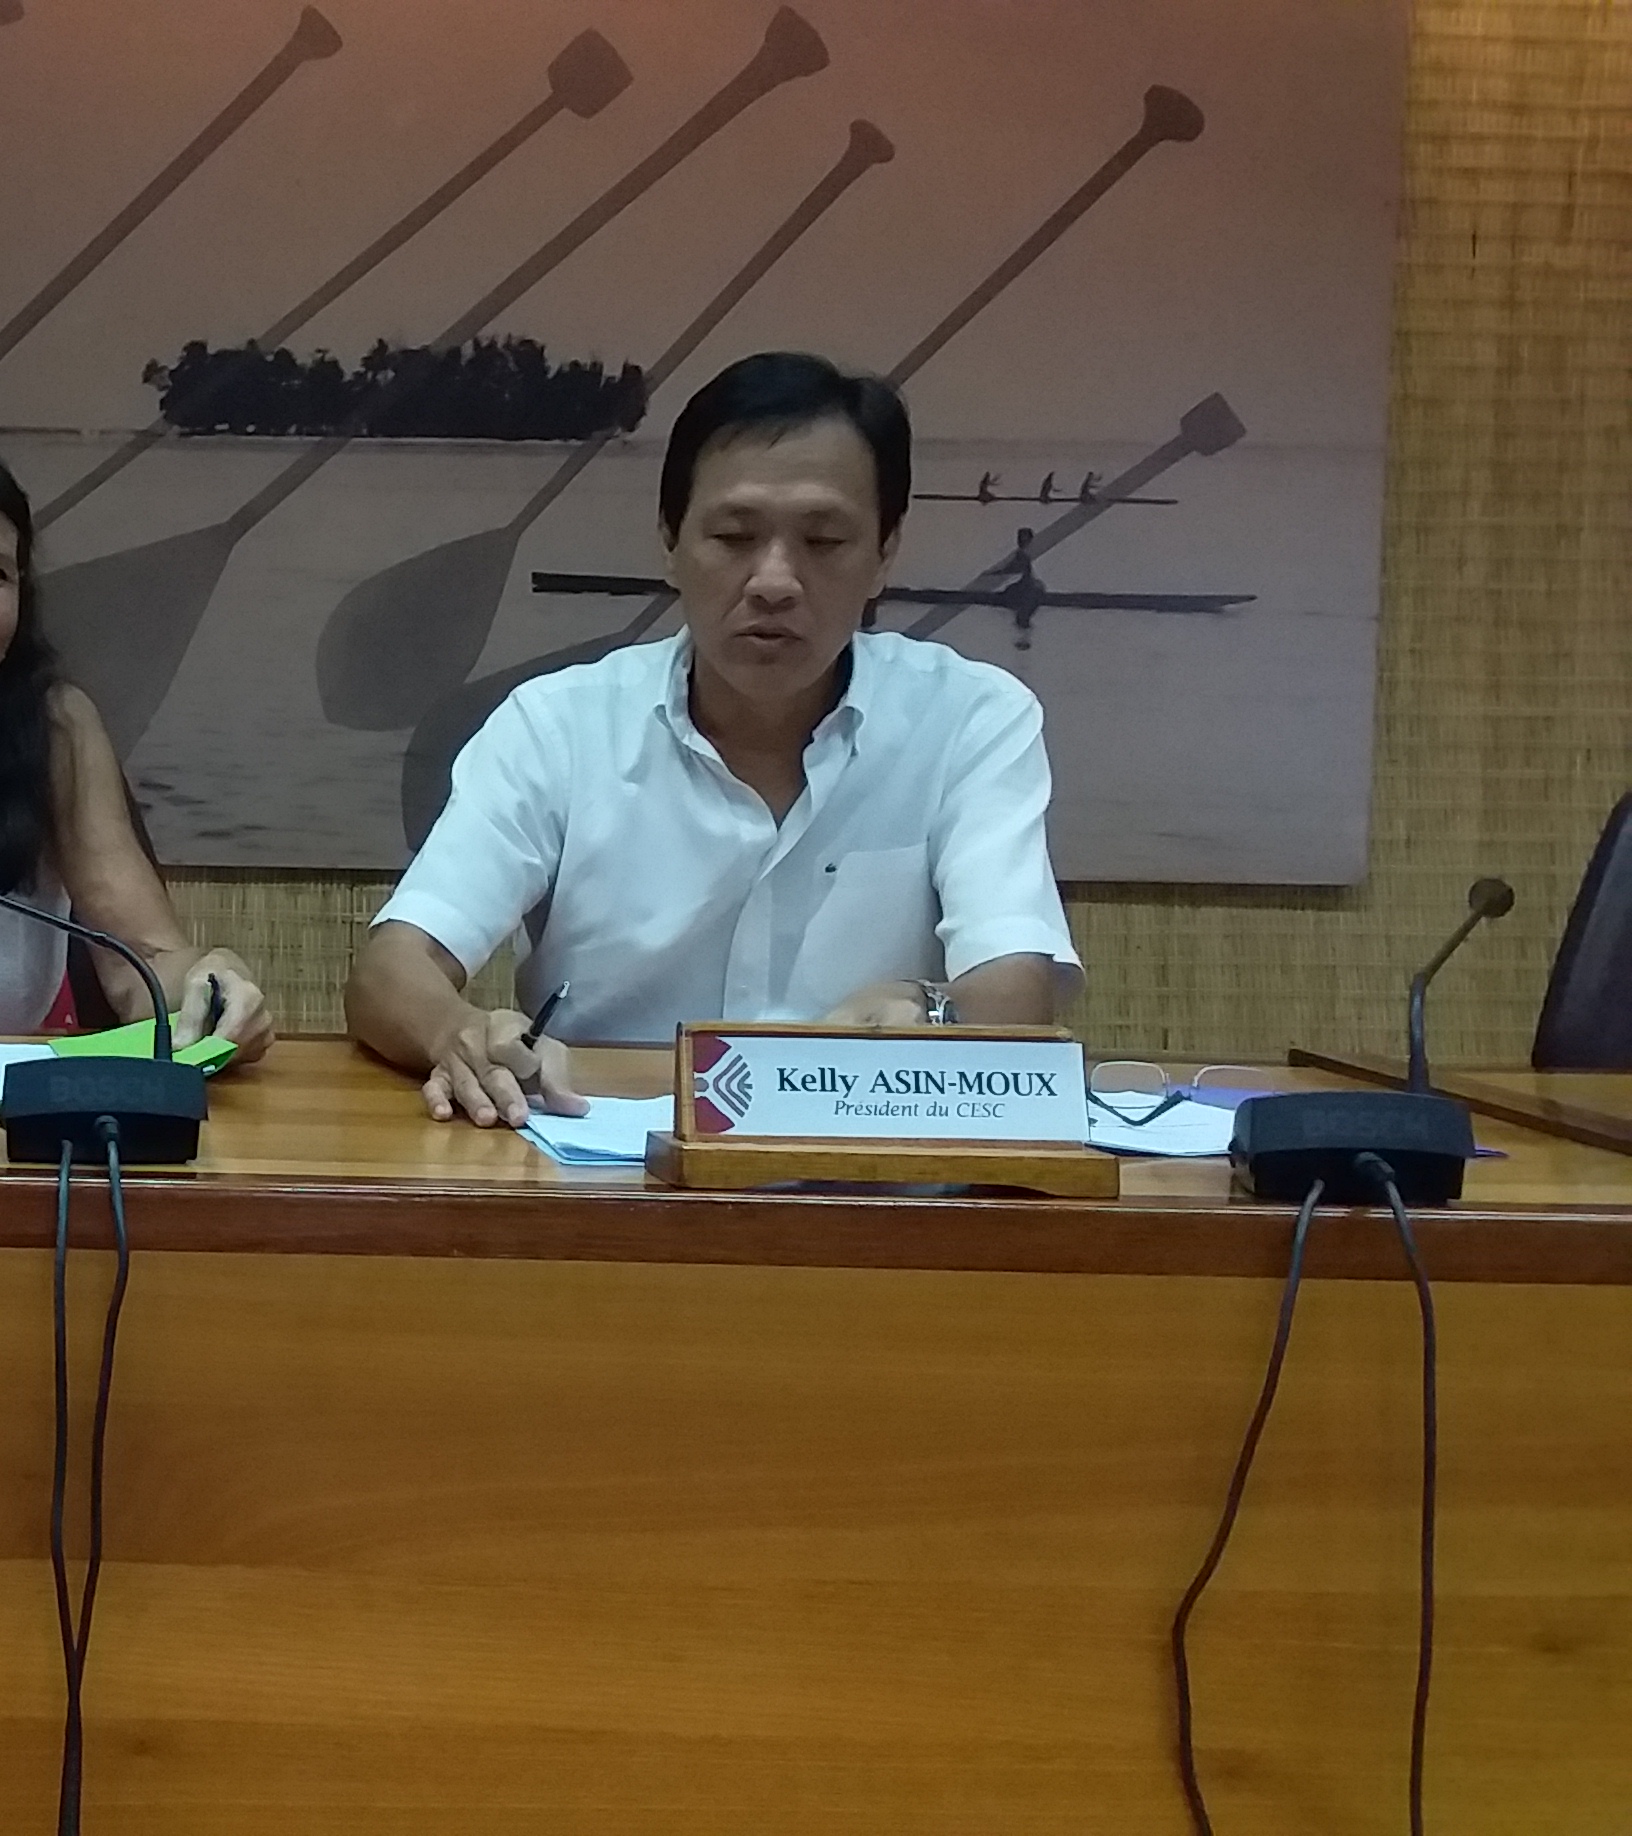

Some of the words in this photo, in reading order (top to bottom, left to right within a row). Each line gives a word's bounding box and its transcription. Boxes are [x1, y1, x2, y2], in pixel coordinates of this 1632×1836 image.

[49, 1075, 166, 1104] BOSCH
[776, 1067, 859, 1098] Kelly
[869, 1070, 1058, 1097] ASIN-MOUX
[834, 1100, 919, 1118] Président
[926, 1101, 949, 1118] du
[956, 1102, 1006, 1119] CESC
